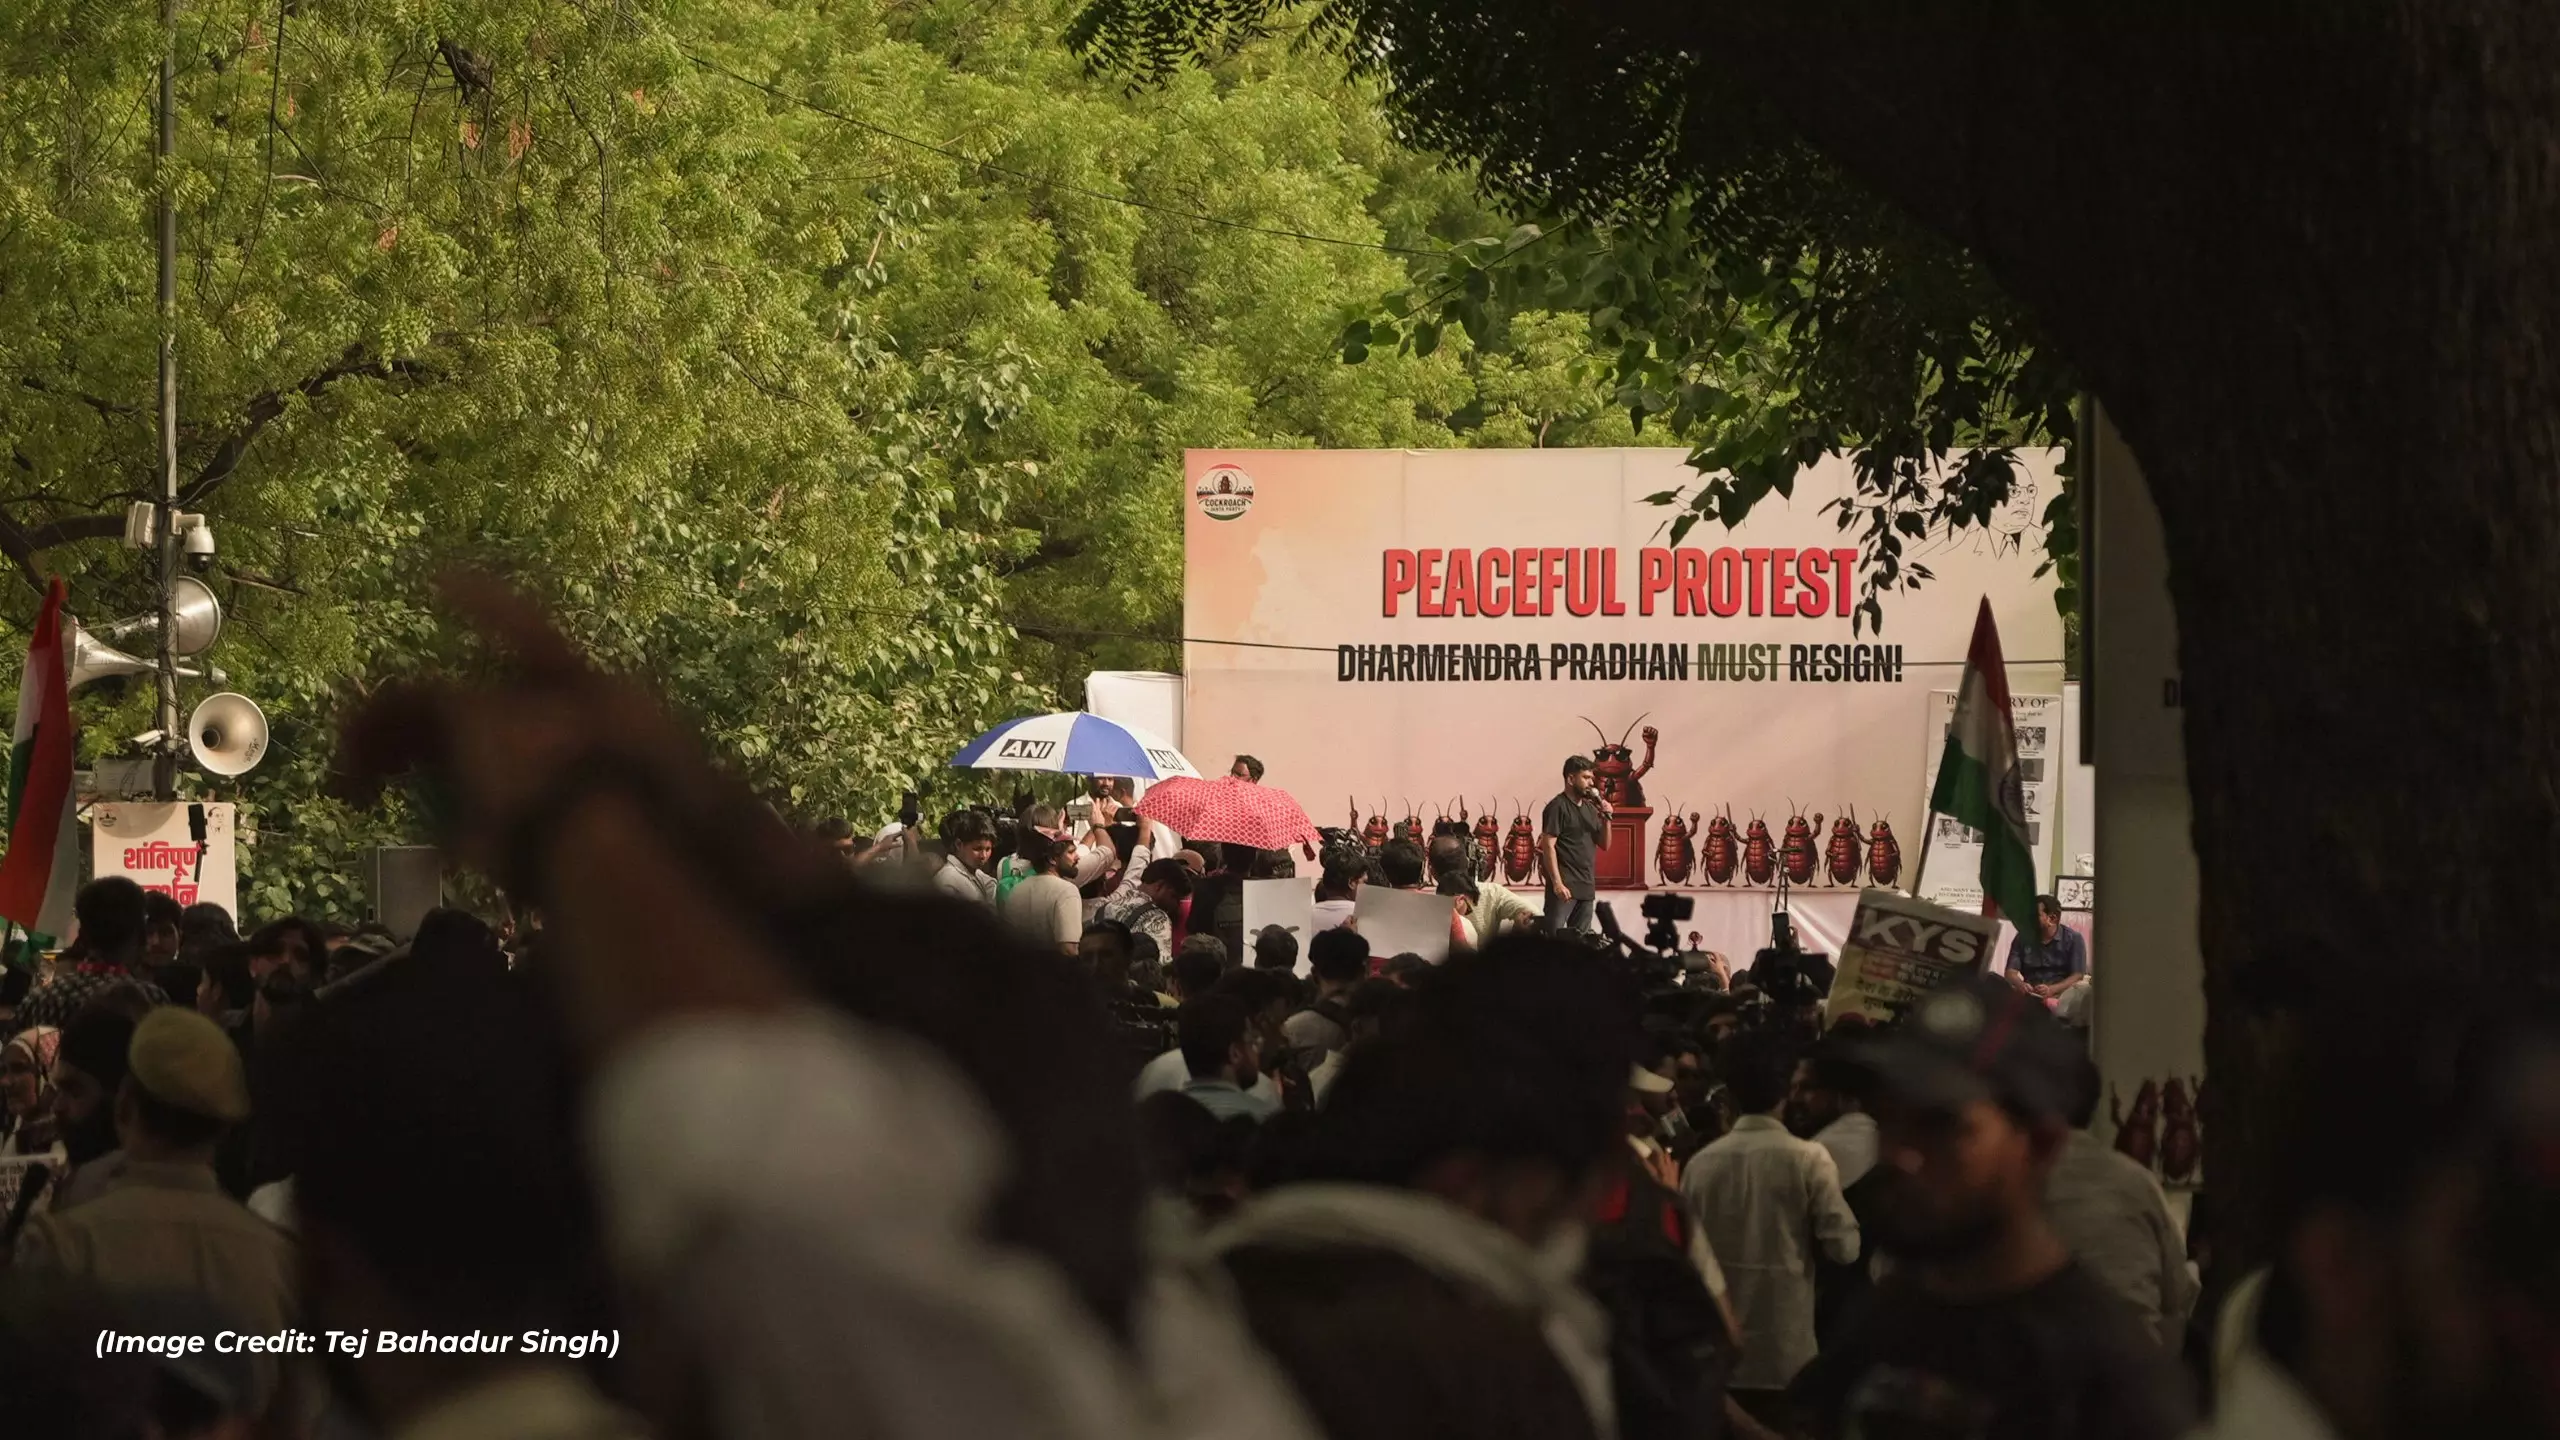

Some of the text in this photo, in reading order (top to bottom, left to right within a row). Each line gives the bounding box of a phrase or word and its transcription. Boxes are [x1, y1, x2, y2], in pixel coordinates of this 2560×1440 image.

[1382, 547, 1859, 618] PEACEFUL PROTEST
[1337, 643, 1904, 682] DHARMENDRA PRADHAN MUST RESIGN!
[2030, 698, 2049, 709] OF
[1001, 740, 1053, 759] ANI
[1859, 907, 1979, 963] KYS
